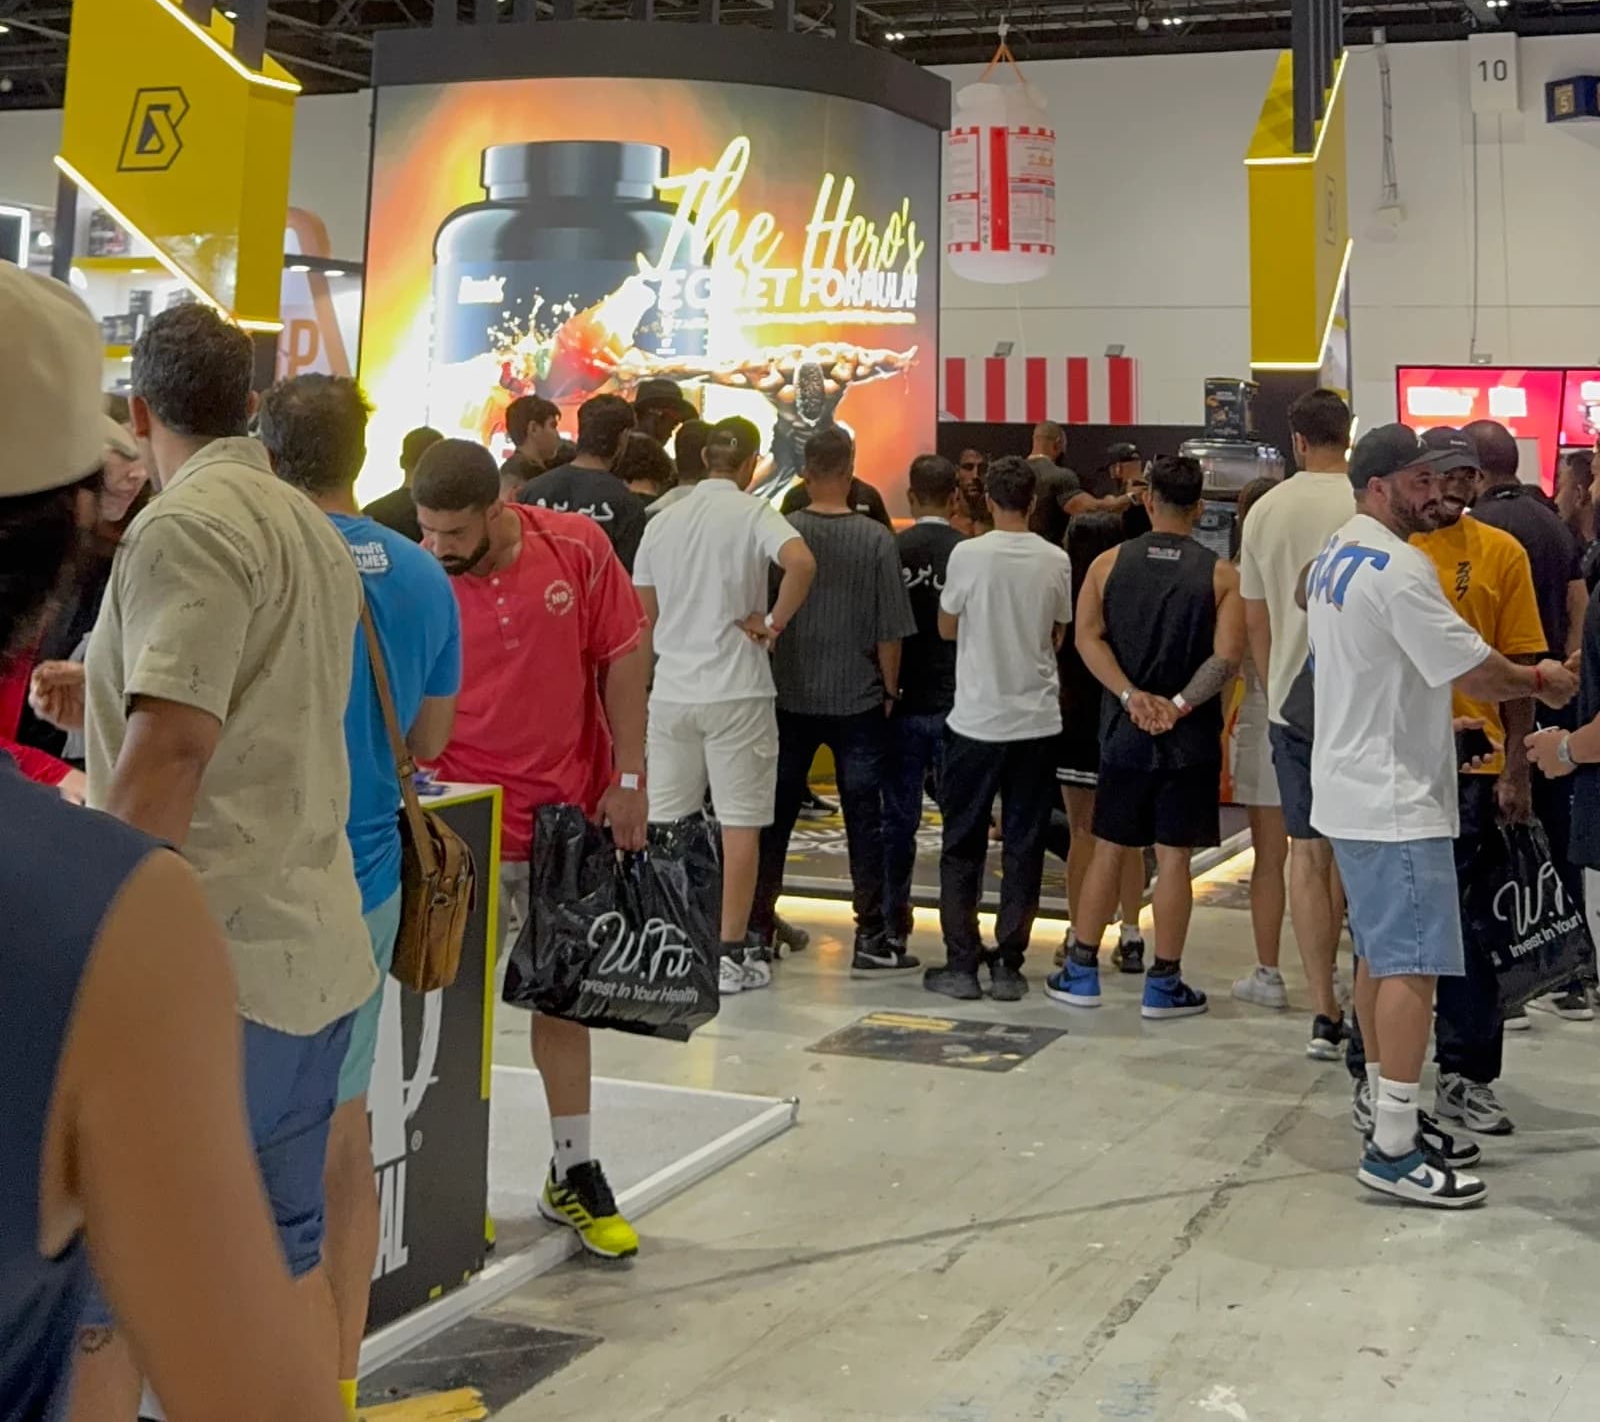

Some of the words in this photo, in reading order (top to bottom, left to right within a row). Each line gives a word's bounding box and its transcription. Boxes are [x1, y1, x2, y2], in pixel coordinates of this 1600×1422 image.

[1478, 59, 1508, 82] 10
[635, 135, 784, 280] The
[801, 172, 925, 276] Hero's
[630, 267, 798, 310] SECET
[1508, 932, 1545, 958] Invest
[579, 979, 618, 998] nvest
[632, 984, 660, 1002] Your
[659, 986, 698, 1003] Health
